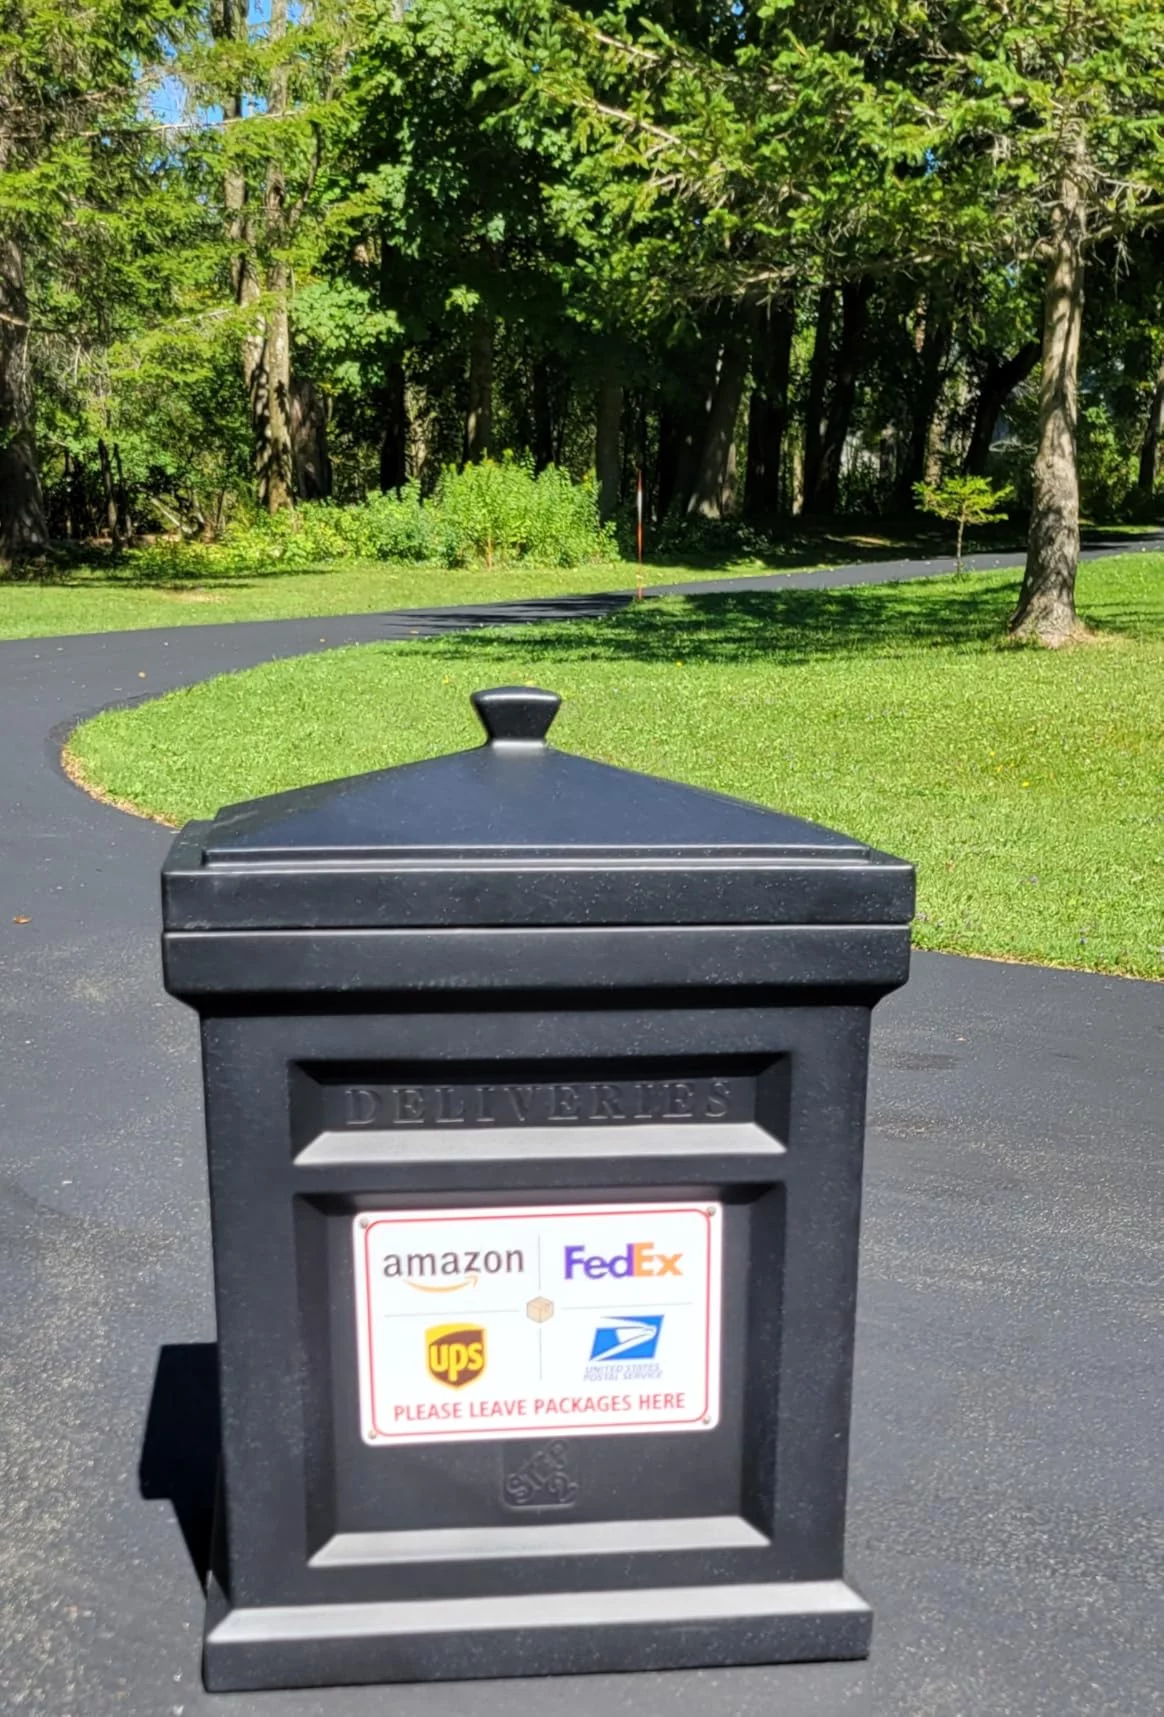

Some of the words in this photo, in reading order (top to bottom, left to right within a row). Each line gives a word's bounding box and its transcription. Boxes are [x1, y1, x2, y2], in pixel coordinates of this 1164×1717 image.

[344, 1078, 732, 1125] DELIVERIES
[383, 1249, 524, 1278] amazon
[564, 1242, 683, 1280] FedEx
[428, 1342, 484, 1382] ups
[394, 1402, 462, 1422] PLEASE
[470, 1399, 526, 1418] LEAVE
[534, 1394, 632, 1415] PACKAGES
[638, 1391, 686, 1411] HERE
